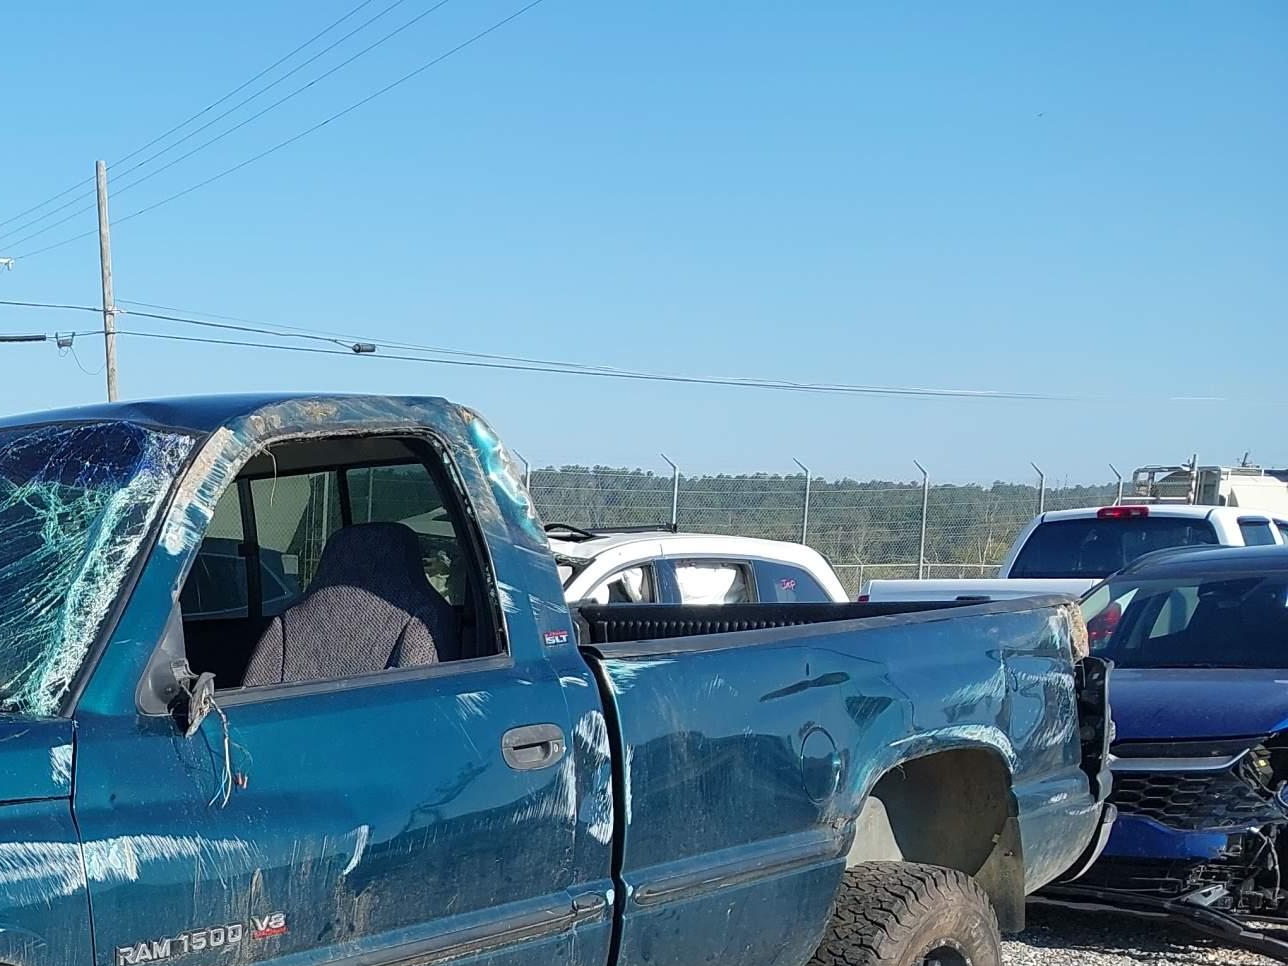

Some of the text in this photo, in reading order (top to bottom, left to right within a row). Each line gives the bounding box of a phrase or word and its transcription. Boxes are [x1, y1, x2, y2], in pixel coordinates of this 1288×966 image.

[545, 633, 569, 645] SLT
[117, 938, 172, 966] RAM
[176, 922, 244, 953] 1500
[250, 912, 288, 931] V8
